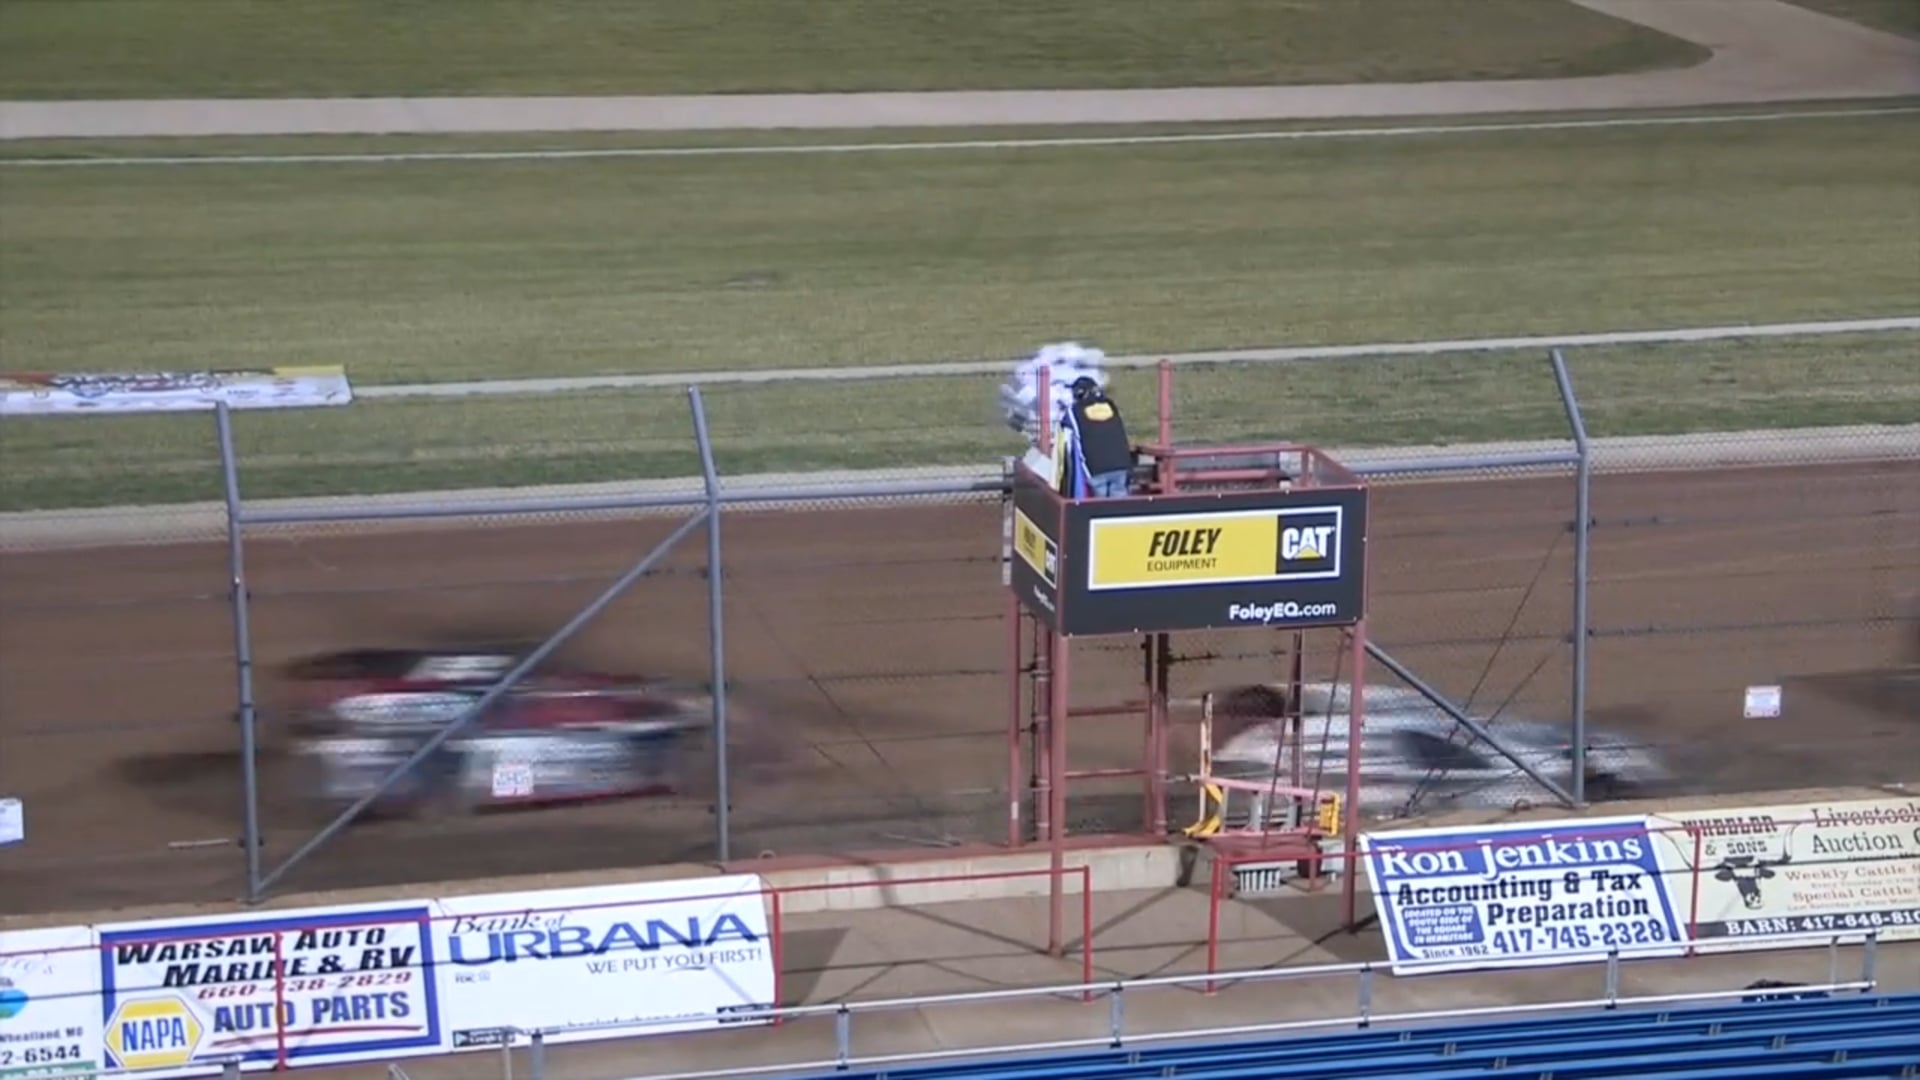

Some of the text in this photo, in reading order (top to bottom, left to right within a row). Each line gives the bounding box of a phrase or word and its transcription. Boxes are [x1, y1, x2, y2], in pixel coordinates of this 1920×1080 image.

[1148, 528, 1222, 557] FOLEY
[1282, 526, 1331, 561] CAT
[1147, 557, 1217, 572] EQUIPMENT
[1229, 601, 1336, 621] FoleyEQ.com
[1681, 815, 1777, 837] WHEELER
[1705, 840, 1768, 856] & SONS
[1812, 831, 1903, 854] Auction
[1376, 833, 1643, 881] Ron Jenkins
[1785, 868, 1848, 881] Weekly
[1855, 865, 1905, 877] Cattle
[1397, 870, 1642, 907] Accounting & Tax
[1792, 886, 1911, 903] Special Cattle
[452, 908, 541, 934] Bank
[1487, 895, 1650, 926] Preparation
[448, 913, 760, 966] URBANA
[1493, 919, 1665, 954] 417-745-2328
[1725, 918, 1797, 935] BARN:
[117, 926, 386, 966] WARSAW AUTO
[1422, 944, 1489, 960] Since 1962
[162, 945, 416, 988] MARINE & RV
[586, 947, 763, 975] WE PUT YOU FIRST!
[213, 990, 411, 1033] AUTO PARTS
[122, 1016, 186, 1053] NAPA
